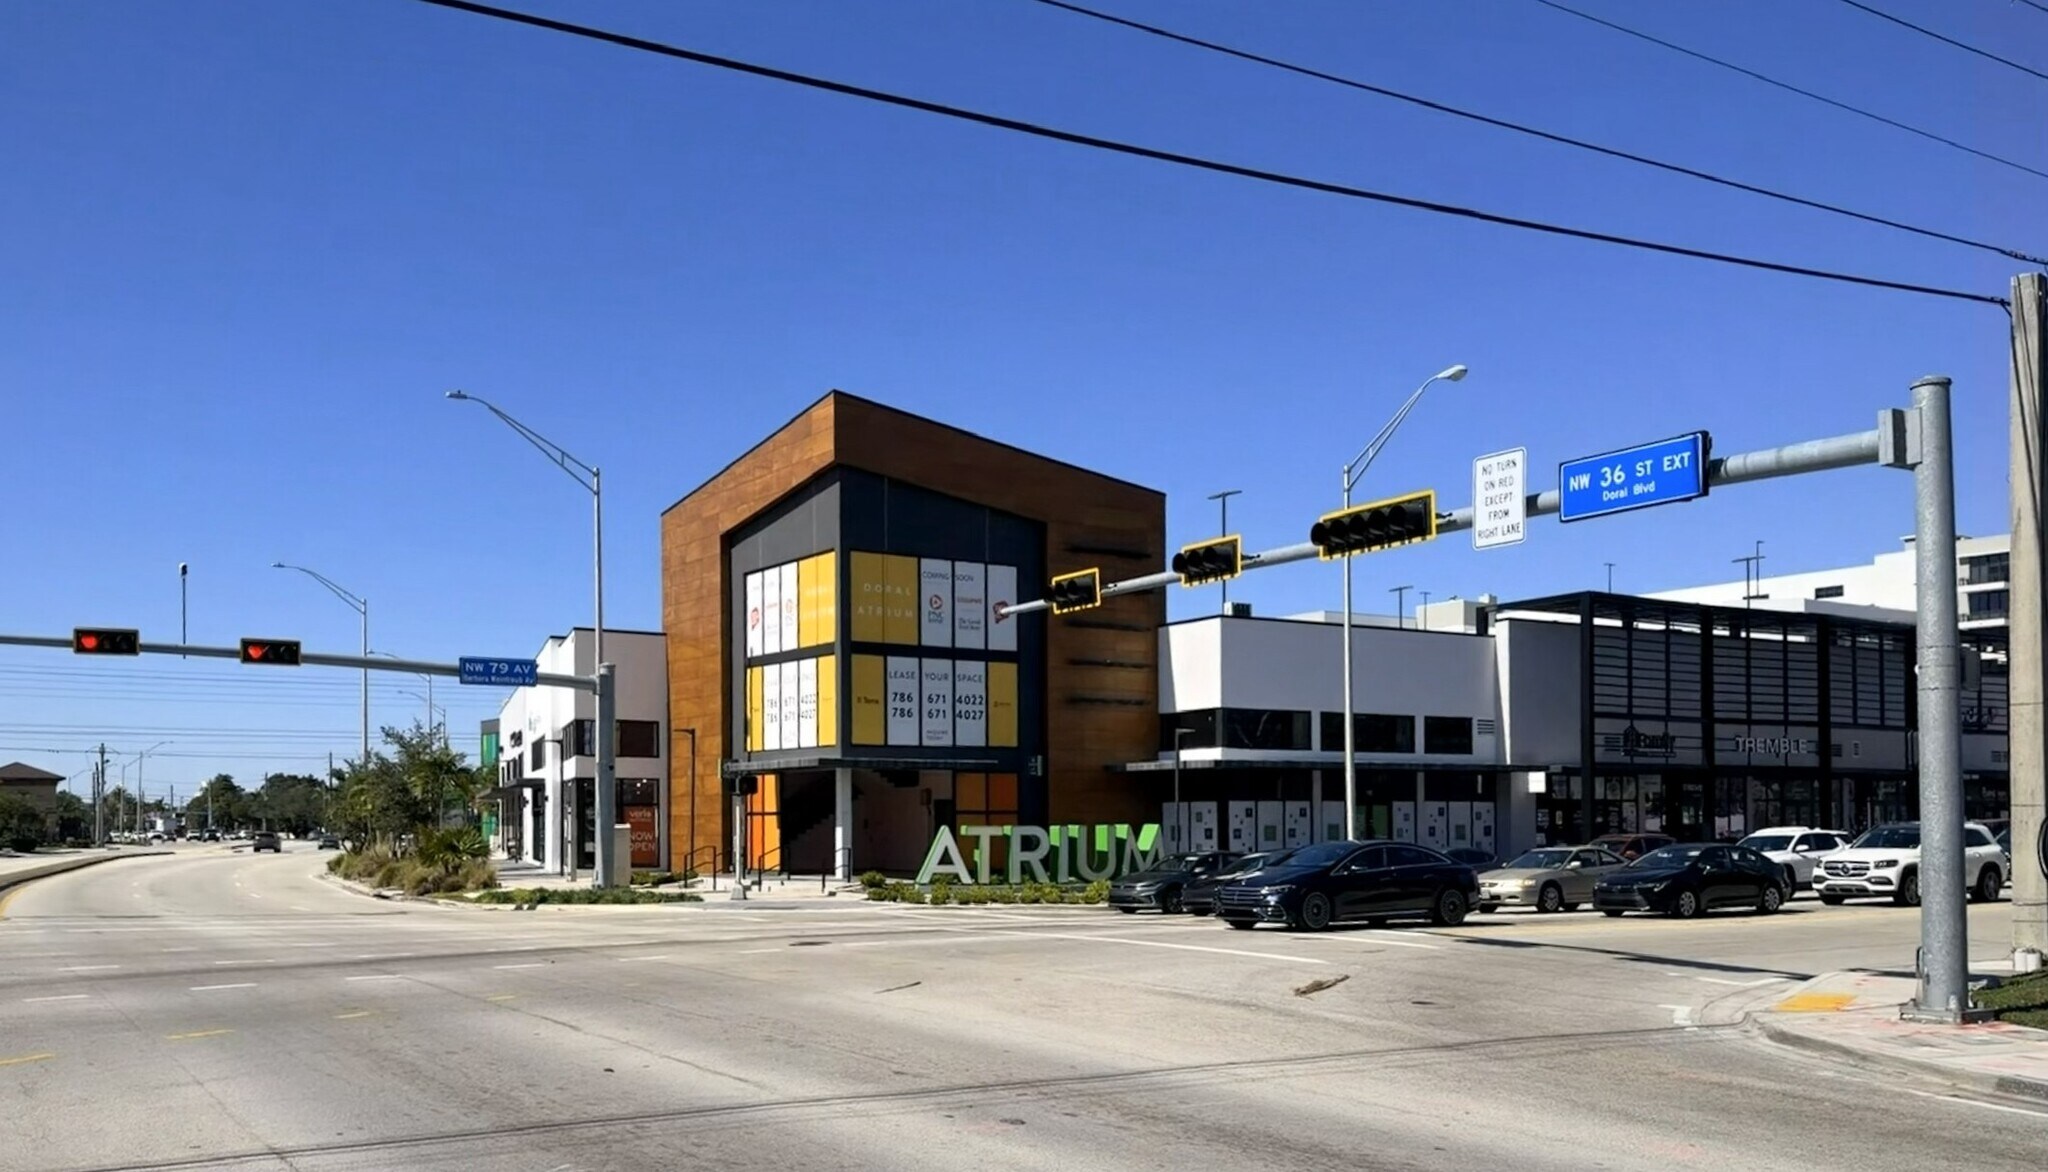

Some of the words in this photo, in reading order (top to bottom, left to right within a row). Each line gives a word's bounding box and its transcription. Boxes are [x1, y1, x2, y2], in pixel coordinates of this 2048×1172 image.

[1482, 464, 1492, 476] NO
[1497, 460, 1517, 471] TURN
[1569, 473, 1591, 492] NW
[1600, 464, 1626, 488] 36
[1636, 460, 1653, 477] ST
[1663, 452, 1691, 472] EXT
[1484, 480, 1495, 491] ON
[1499, 476, 1514, 488] RED
[1602, 488, 1628, 501] Doral
[1633, 481, 1656, 495] Blvd
[1485, 492, 1513, 507] EXCEPT
[1489, 509, 1510, 521] FROM
[1478, 527, 1498, 539] RIGHT
[1502, 522, 1521, 536] LANE
[922, 571, 949, 580] COMING
[955, 573, 974, 582] SOON
[864, 583, 911, 596] DORAL
[858, 606, 913, 618] ATRIUM
[465, 662, 485, 672] NW
[489, 662, 509, 674] 79
[513, 664, 531, 674] AV
[889, 671, 915, 680] LEASE
[925, 672, 949, 681] YOUR
[957, 674, 982, 683] SPACE
[892, 692, 914, 703] 786
[927, 693, 946, 704] 671
[956, 694, 984, 706] 4022
[892, 707, 914, 718] 786
[927, 708, 946, 719] 671
[956, 709, 984, 720] 4027
[1735, 737, 1808, 754] TREMBLE
[915, 824, 1166, 885] ATRIUM
